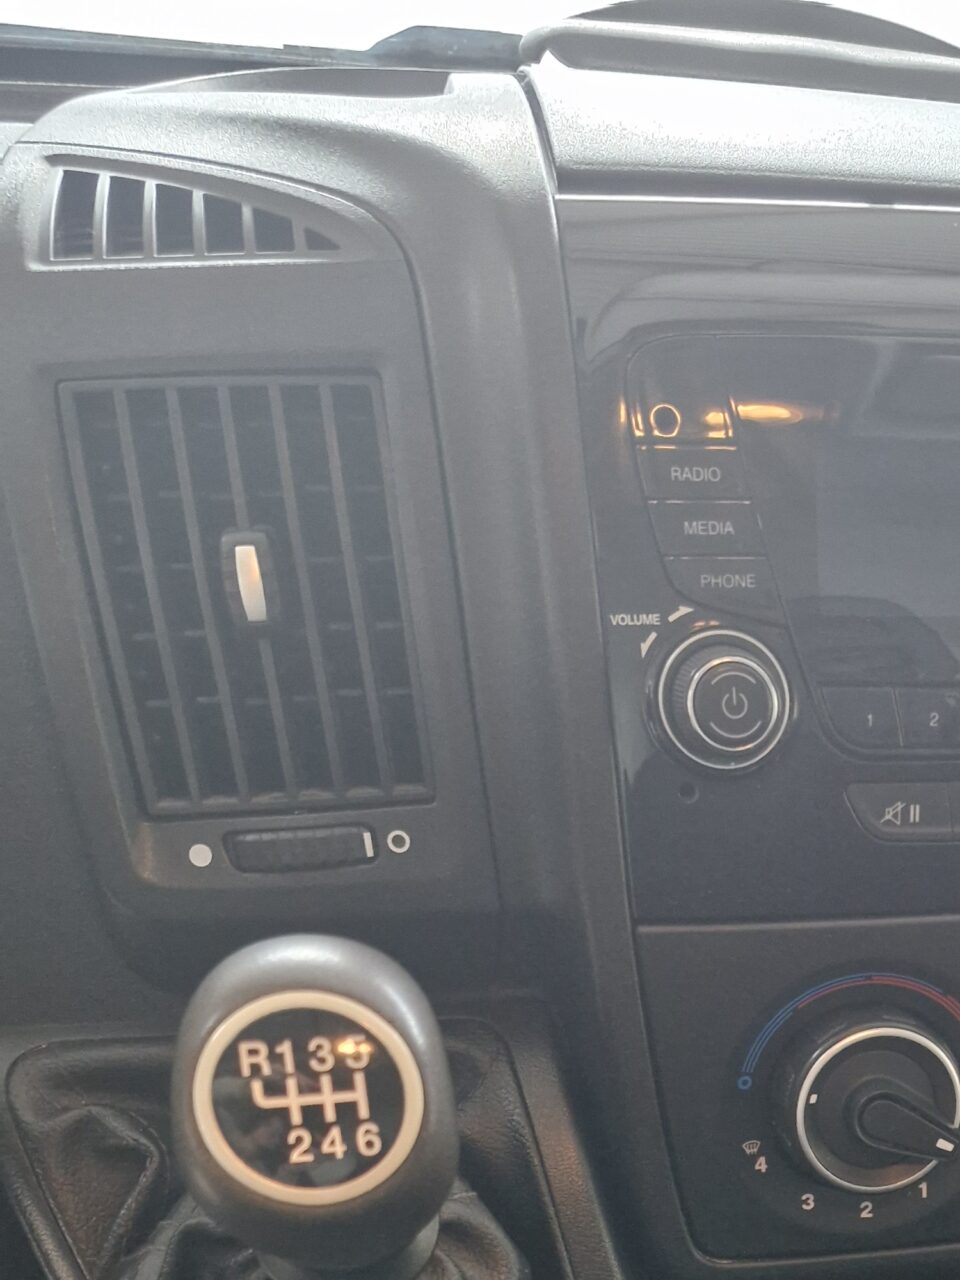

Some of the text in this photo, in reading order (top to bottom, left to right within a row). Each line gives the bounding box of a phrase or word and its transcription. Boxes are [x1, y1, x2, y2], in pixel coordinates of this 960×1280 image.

[670, 467, 721, 482] RADIO
[683, 521, 735, 536] MEDIA
[700, 574, 756, 589] PHONE
[609, 613, 661, 627] VOLUME
[866, 713, 874, 728] 1
[929, 712, 940, 727] 2
[754, 1156, 768, 1173] 4
[918, 1182, 928, 1199] 1
[801, 1193, 815, 1210] 3
[860, 1201, 873, 1218] 2
